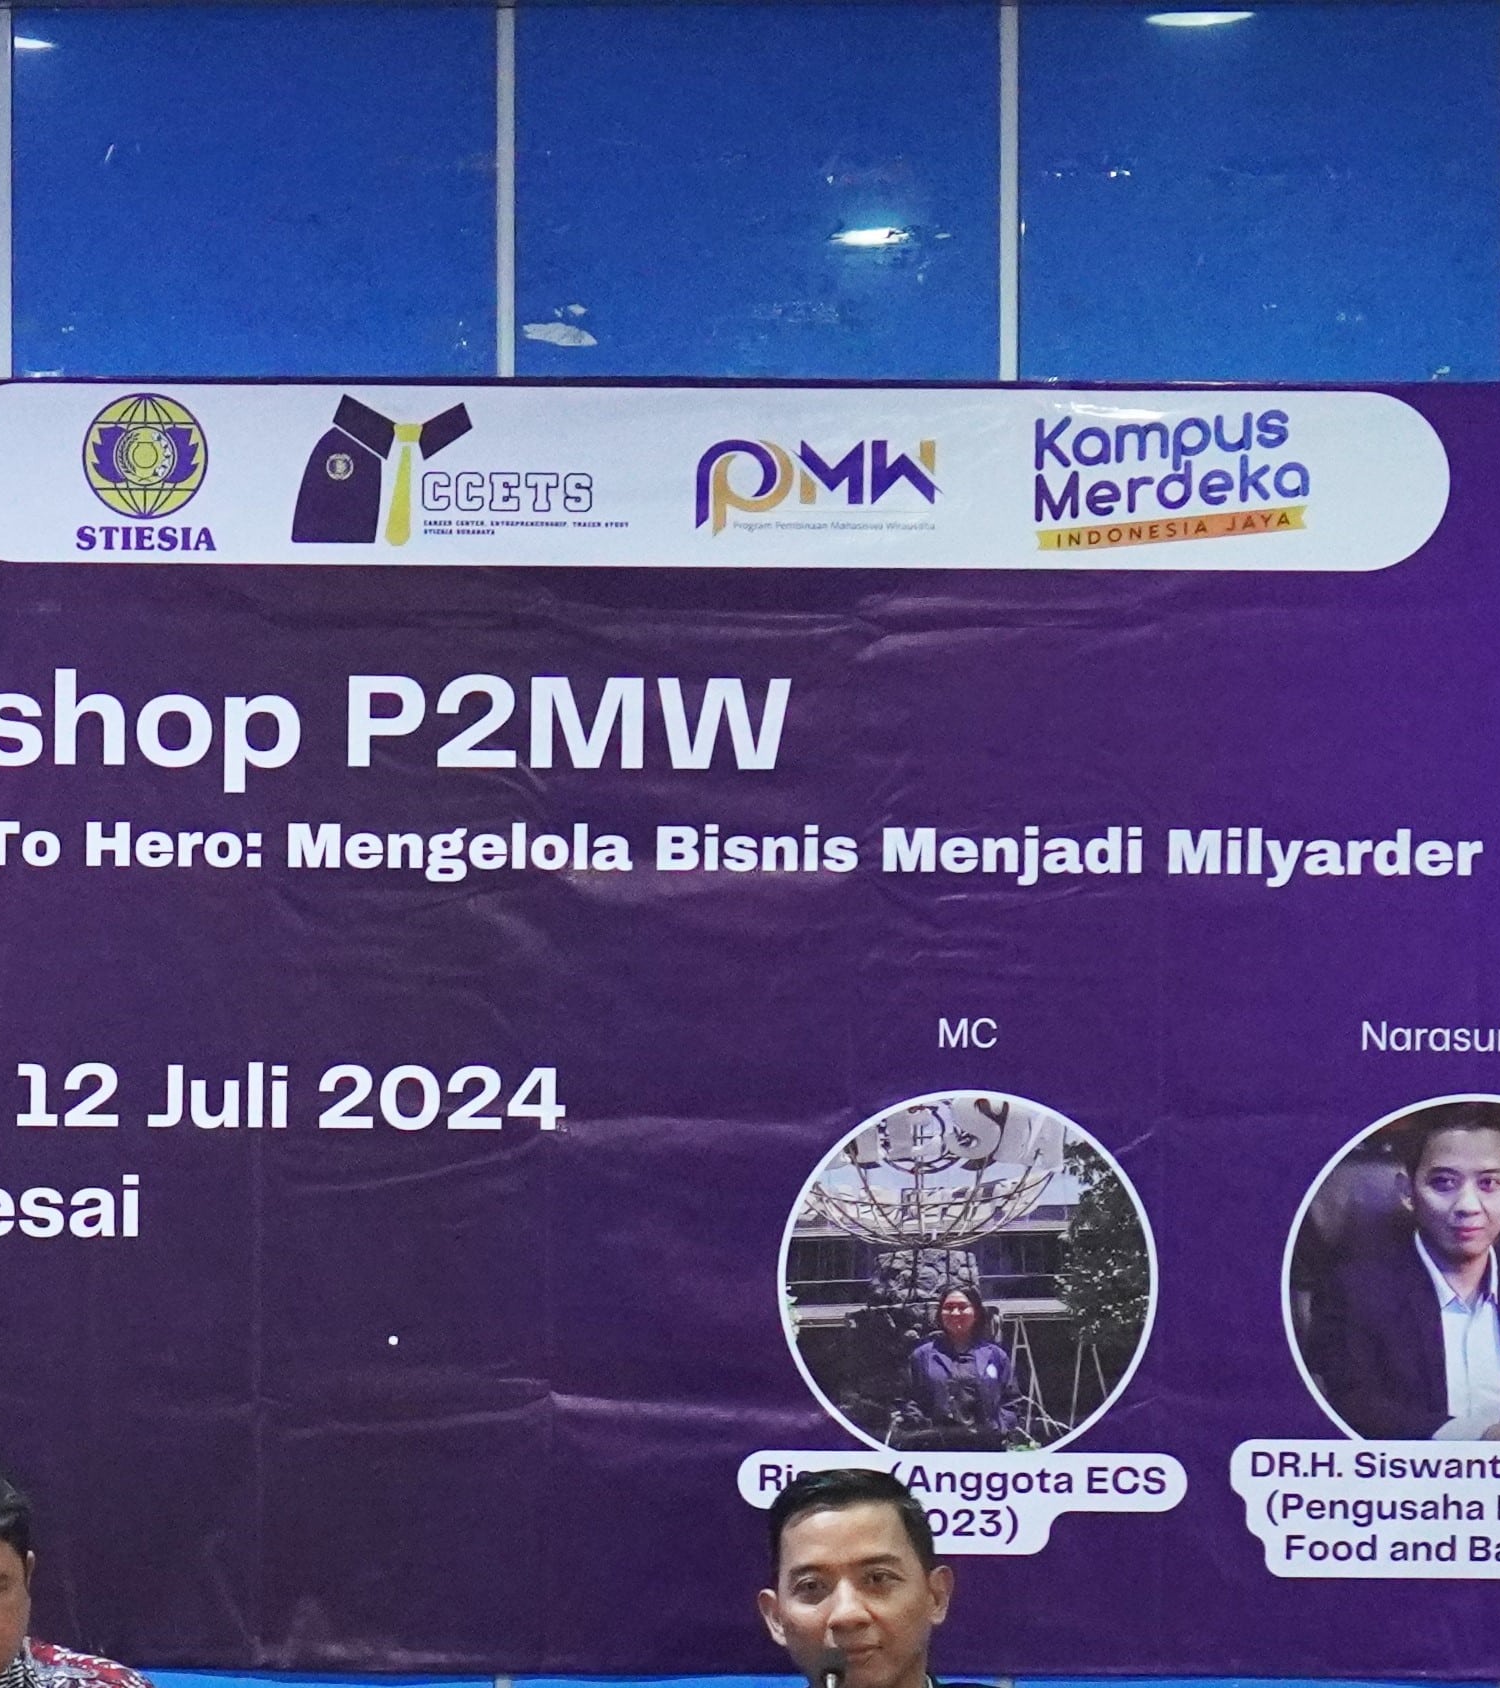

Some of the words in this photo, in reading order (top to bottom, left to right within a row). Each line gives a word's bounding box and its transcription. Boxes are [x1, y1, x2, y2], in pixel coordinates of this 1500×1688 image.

[1035, 409, 1289, 471] Kampus
[421, 472, 593, 513] CCETS
[1035, 454, 1310, 523] Merdeka
[75, 525, 217, 552] STIESIA
[1056, 521, 1208, 549] INDONESIA
[1227, 512, 1293, 533] JAYA
[347, 674, 792, 770] P2MW
[86, 820, 264, 867] Hero:
[286, 822, 633, 883] Mengelola
[656, 825, 859, 874] Bisnis
[882, 825, 1143, 886] Menjadi
[1168, 828, 1484, 888] Milyarder
[937, 1018, 999, 1051] MC
[15, 1062, 119, 1128] 12
[147, 1061, 288, 1130] Juli
[317, 1063, 567, 1132] 2024
[1087, 1466, 1167, 1495] ECS
[1251, 1451, 1343, 1479] DR.H.
[926, 1506, 1019, 1545] 023)
[1266, 1490, 1485, 1527] (Pengusaha
[1285, 1534, 1377, 1562] Food
[1389, 1535, 1456, 1562] and
